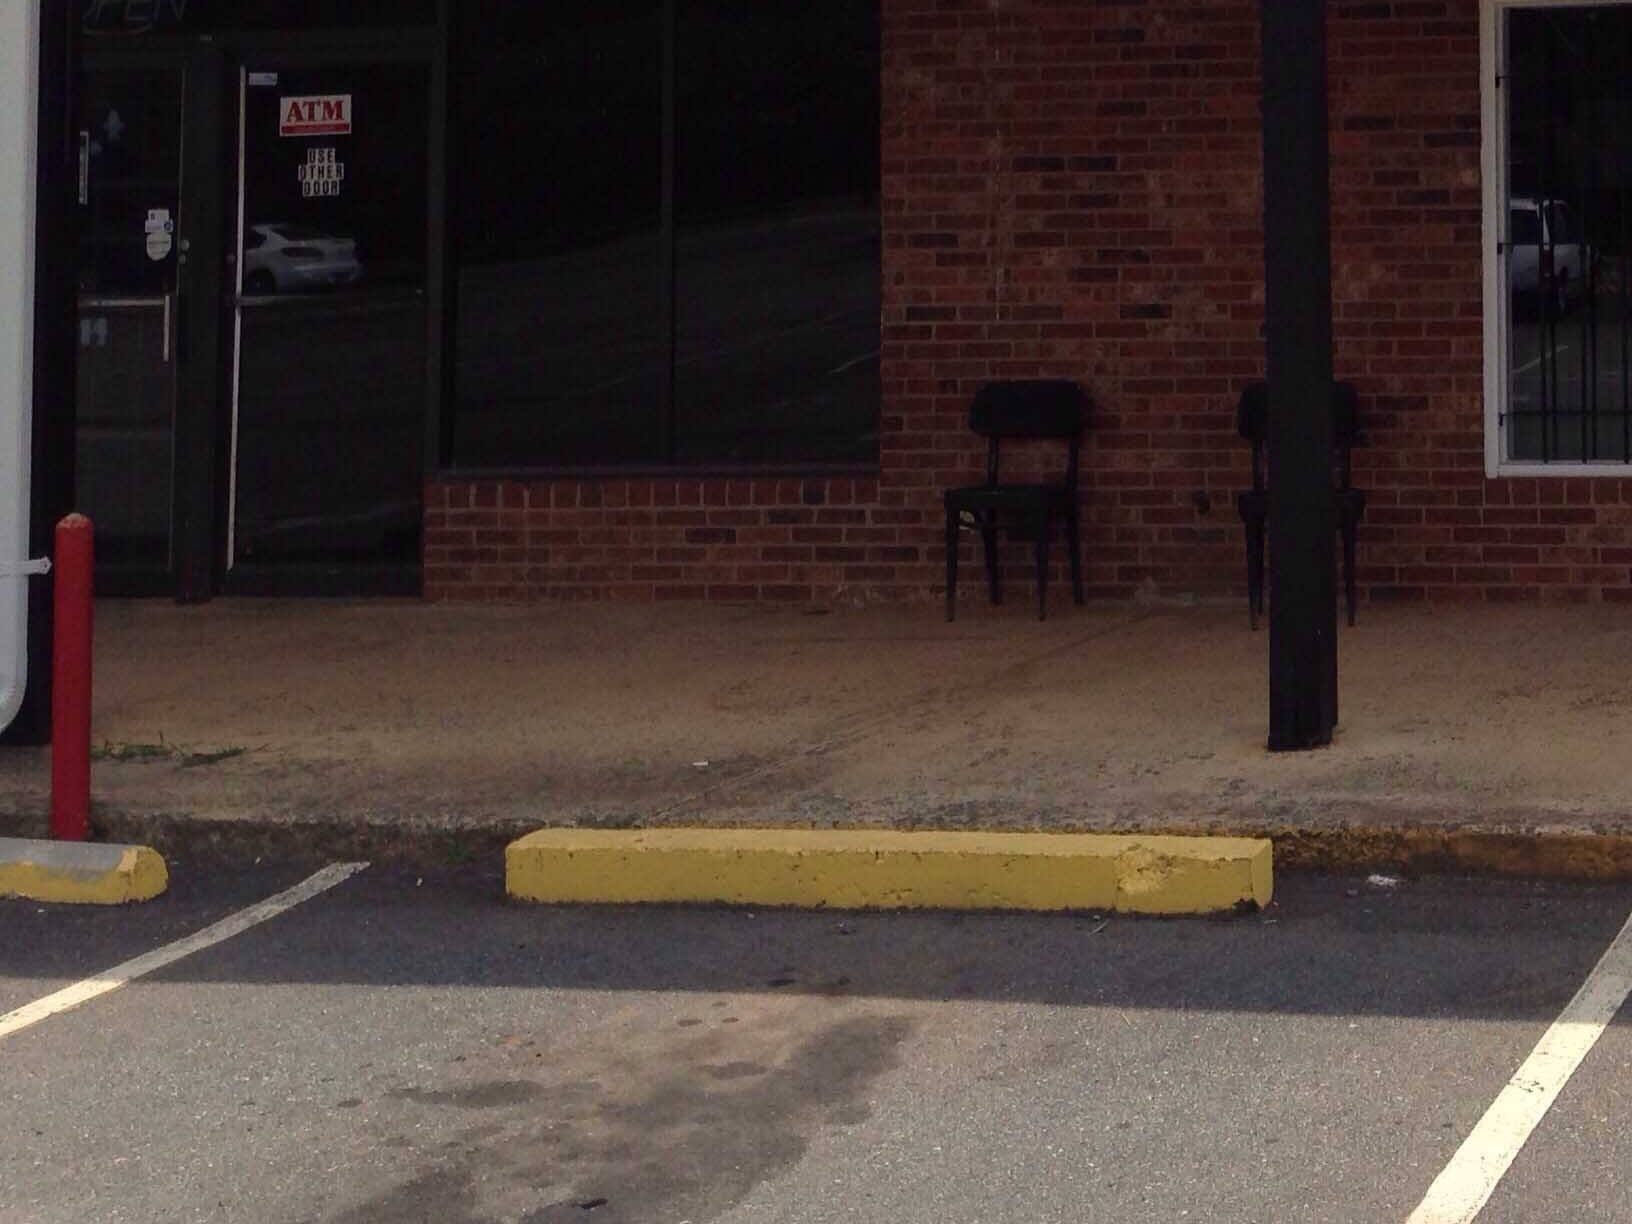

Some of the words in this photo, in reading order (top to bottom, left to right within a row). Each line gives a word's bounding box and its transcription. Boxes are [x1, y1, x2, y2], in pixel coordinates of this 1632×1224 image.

[287, 100, 344, 122] ATM
[308, 149, 335, 163] USE
[298, 164, 344, 180] OTHER
[303, 180, 339, 195] DOOR
